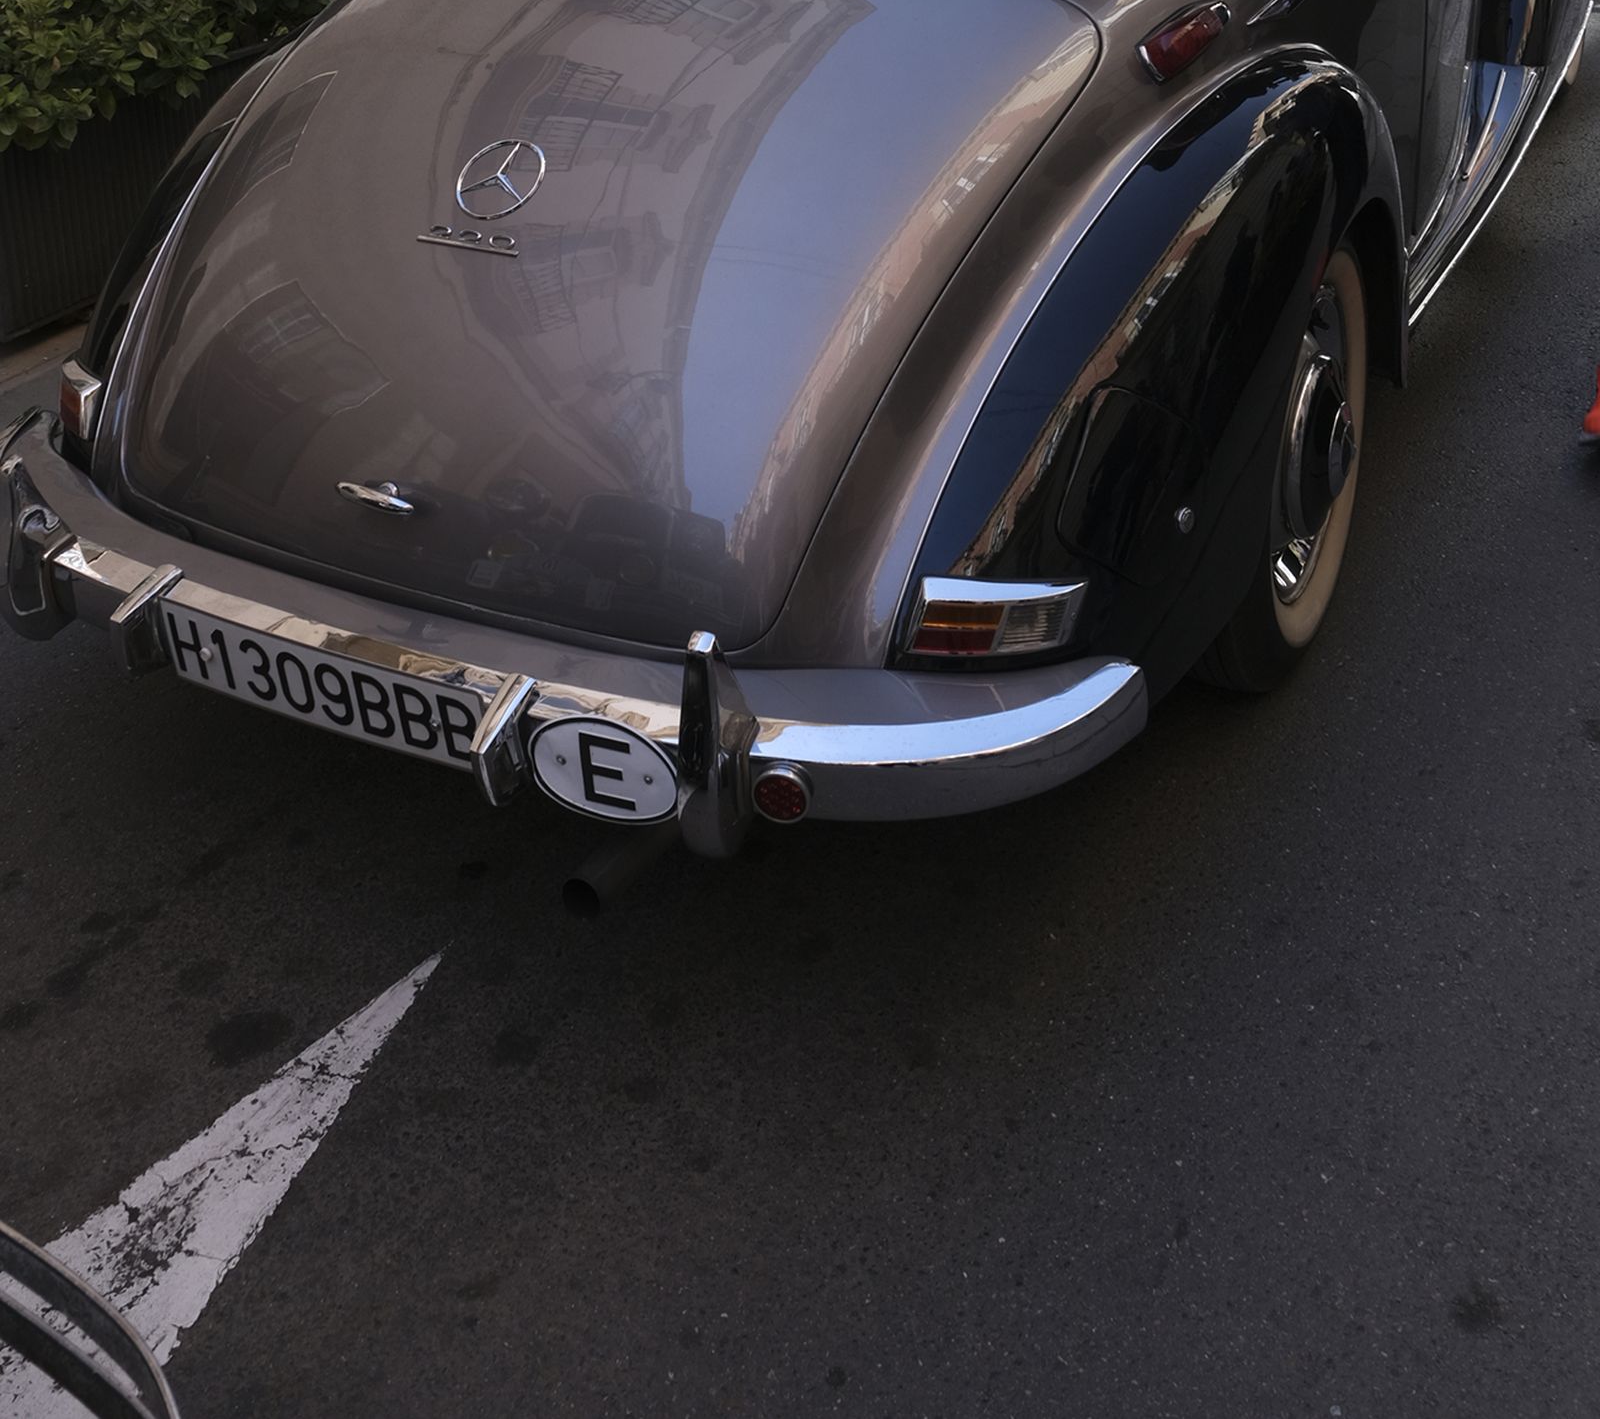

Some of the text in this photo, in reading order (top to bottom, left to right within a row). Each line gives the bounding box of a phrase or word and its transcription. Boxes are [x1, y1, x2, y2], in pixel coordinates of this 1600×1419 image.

[429, 224, 516, 251] 220
[167, 612, 476, 762] H1309BBB
[578, 730, 637, 812] E
